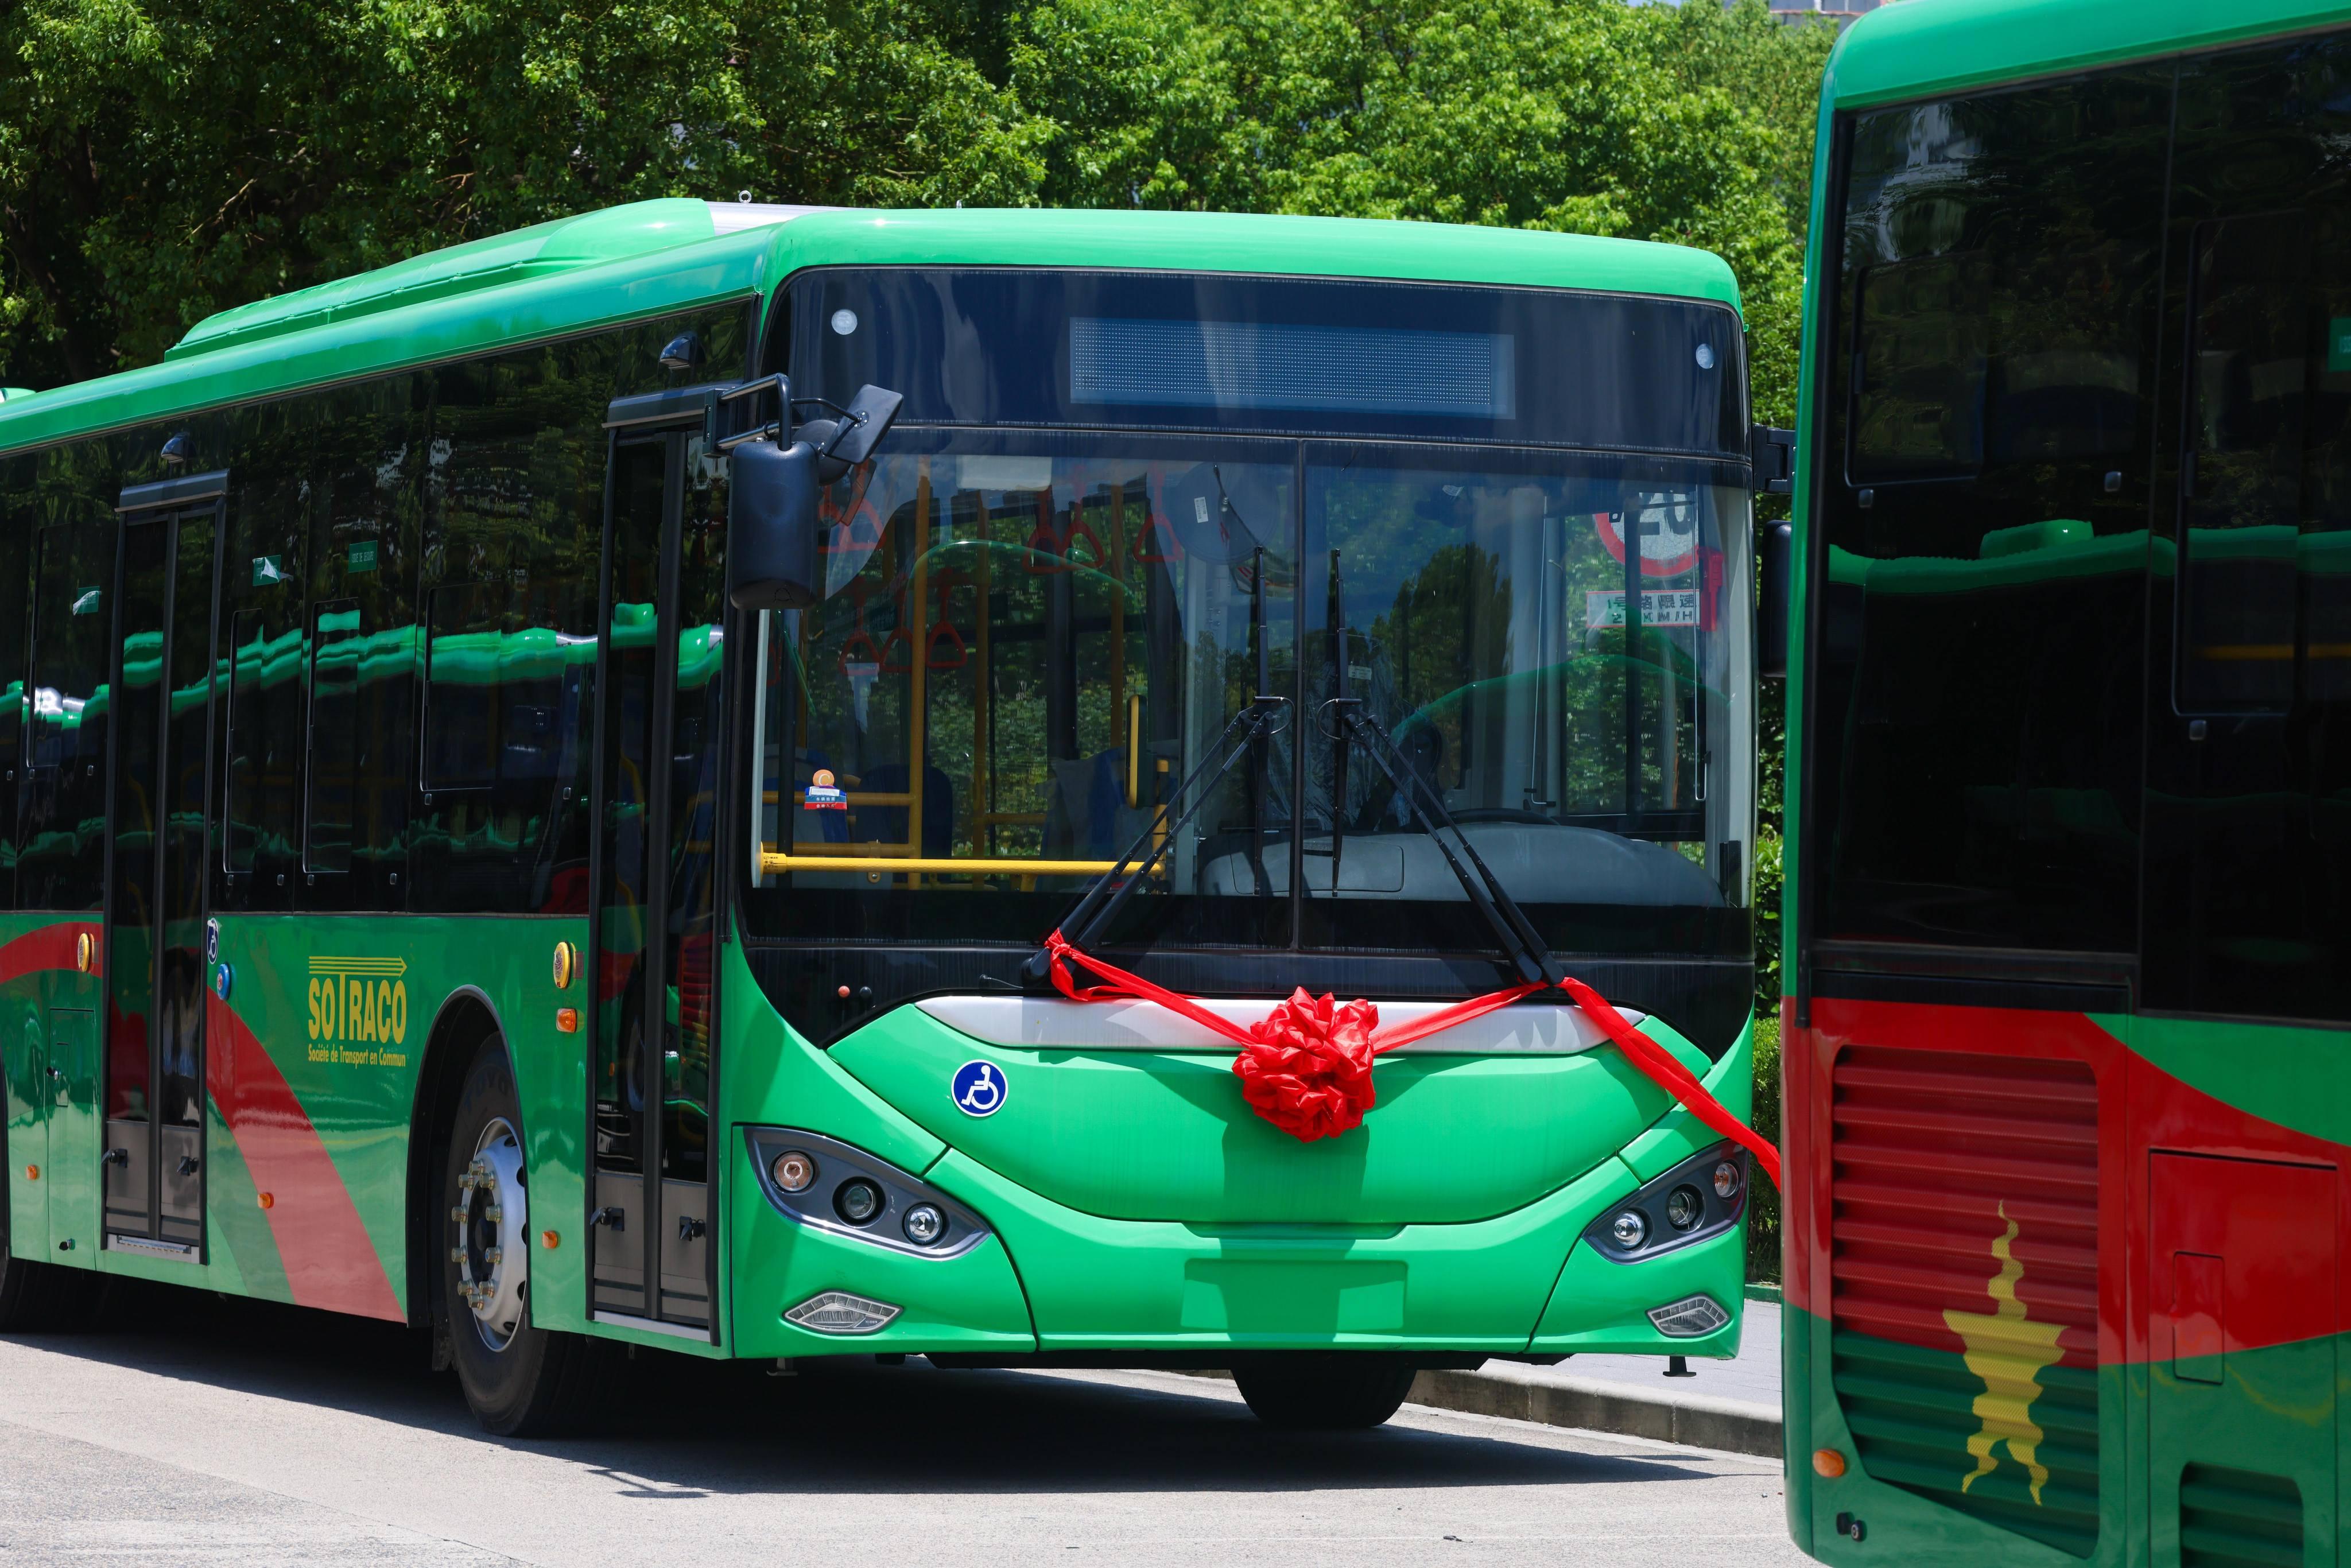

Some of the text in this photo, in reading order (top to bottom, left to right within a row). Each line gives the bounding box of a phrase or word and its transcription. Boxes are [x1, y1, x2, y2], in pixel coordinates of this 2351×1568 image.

[309, 973, 406, 1045] SOTRACO
[308, 1043, 406, 1069] Société de Transport en Commun
